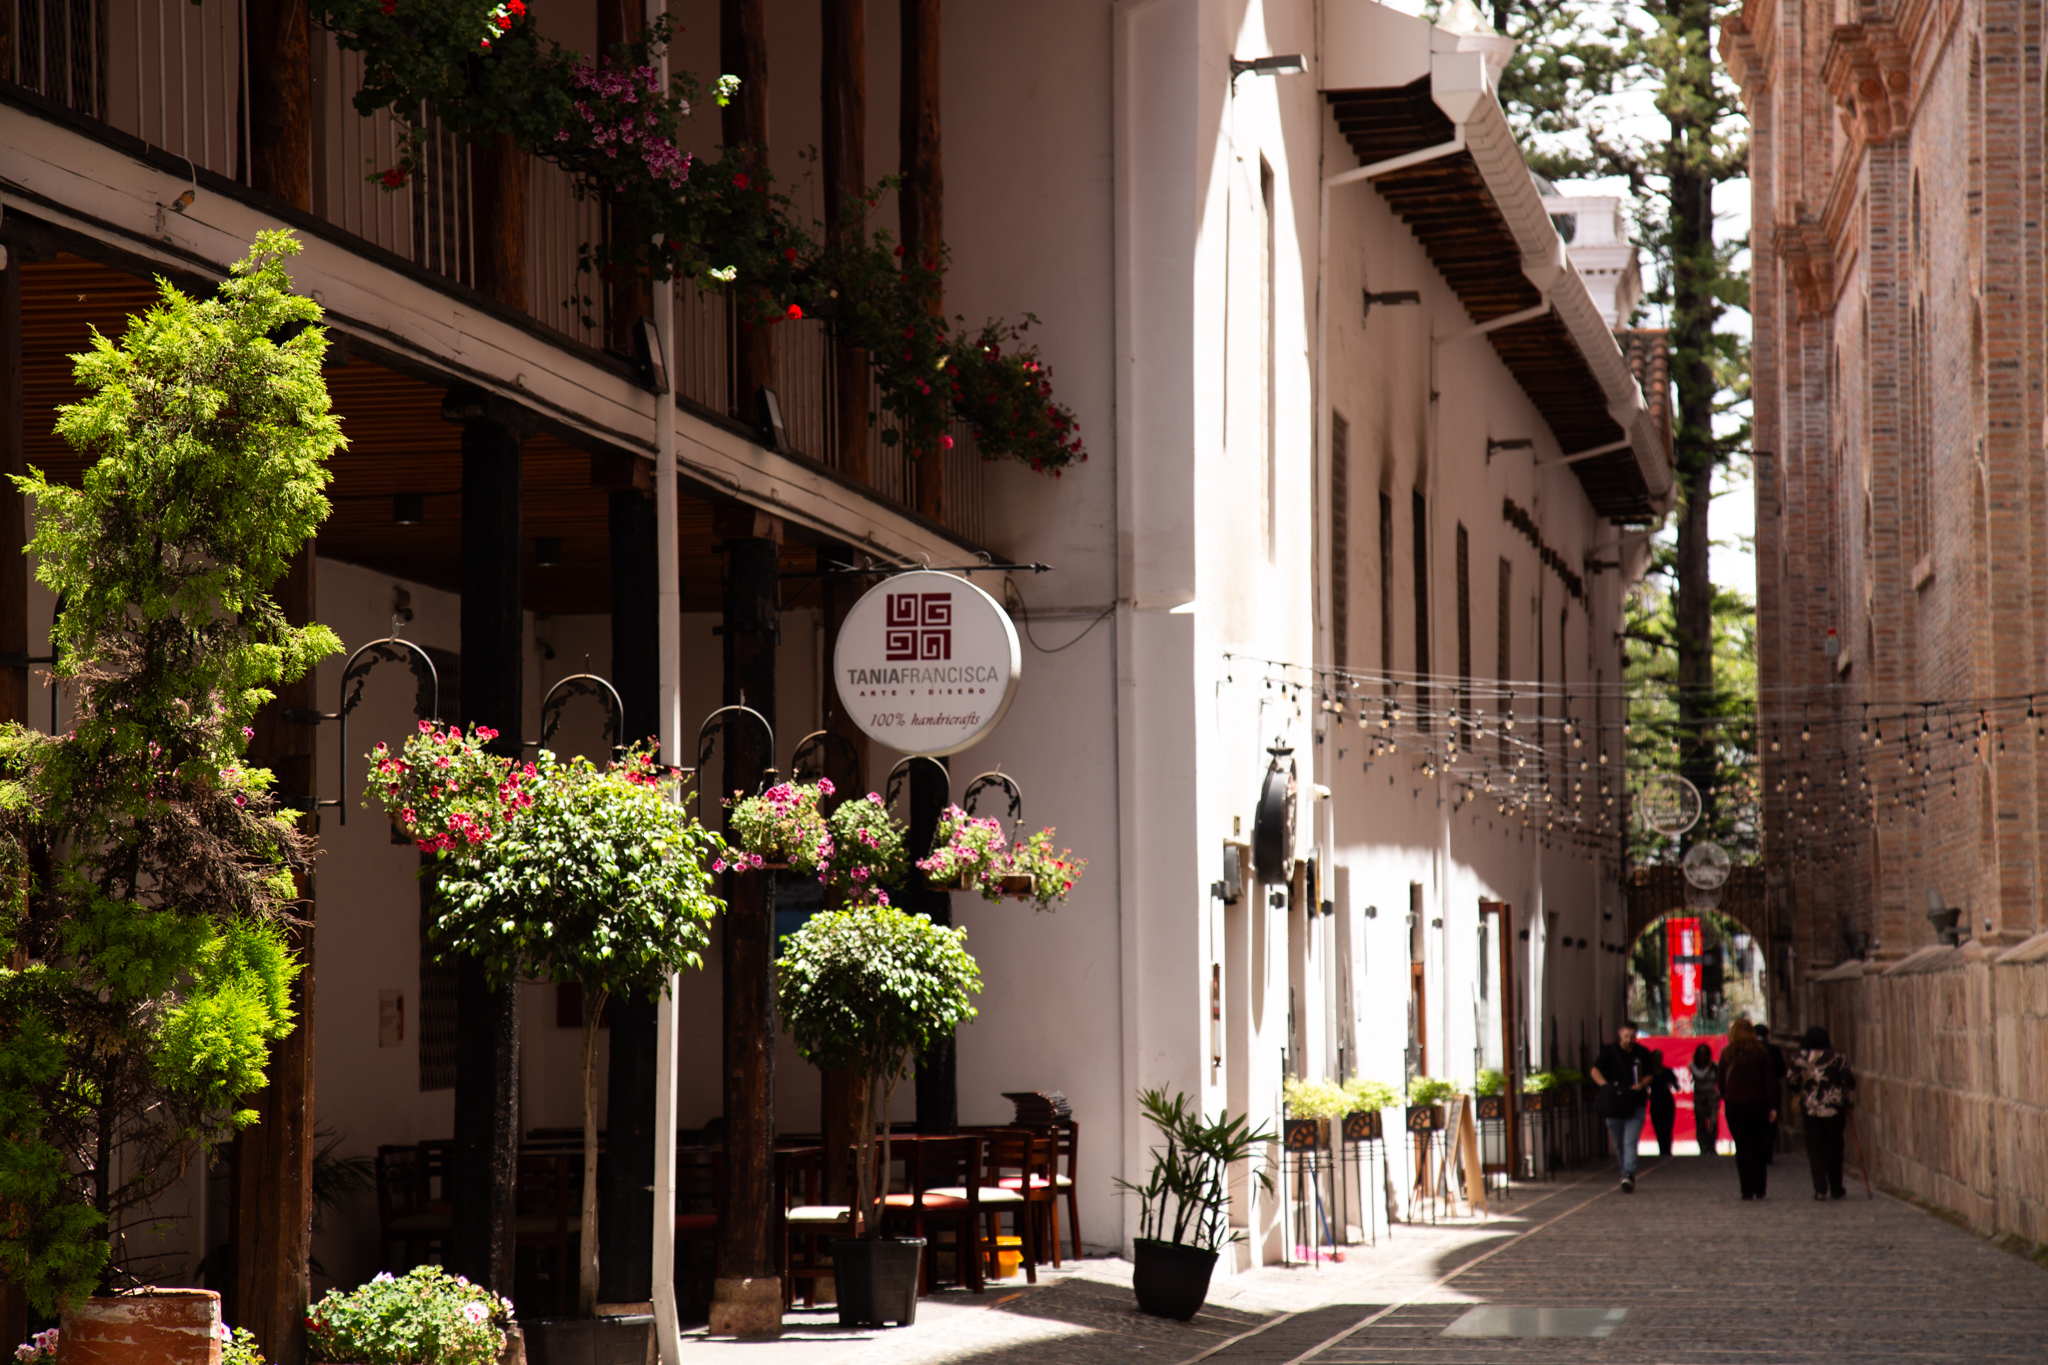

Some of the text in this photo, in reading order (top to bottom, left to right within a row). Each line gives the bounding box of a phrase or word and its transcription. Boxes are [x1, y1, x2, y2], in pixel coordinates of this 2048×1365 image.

[928, 687, 986, 696] DISEÑO
[870, 711, 981, 730] 100% handricrafts
